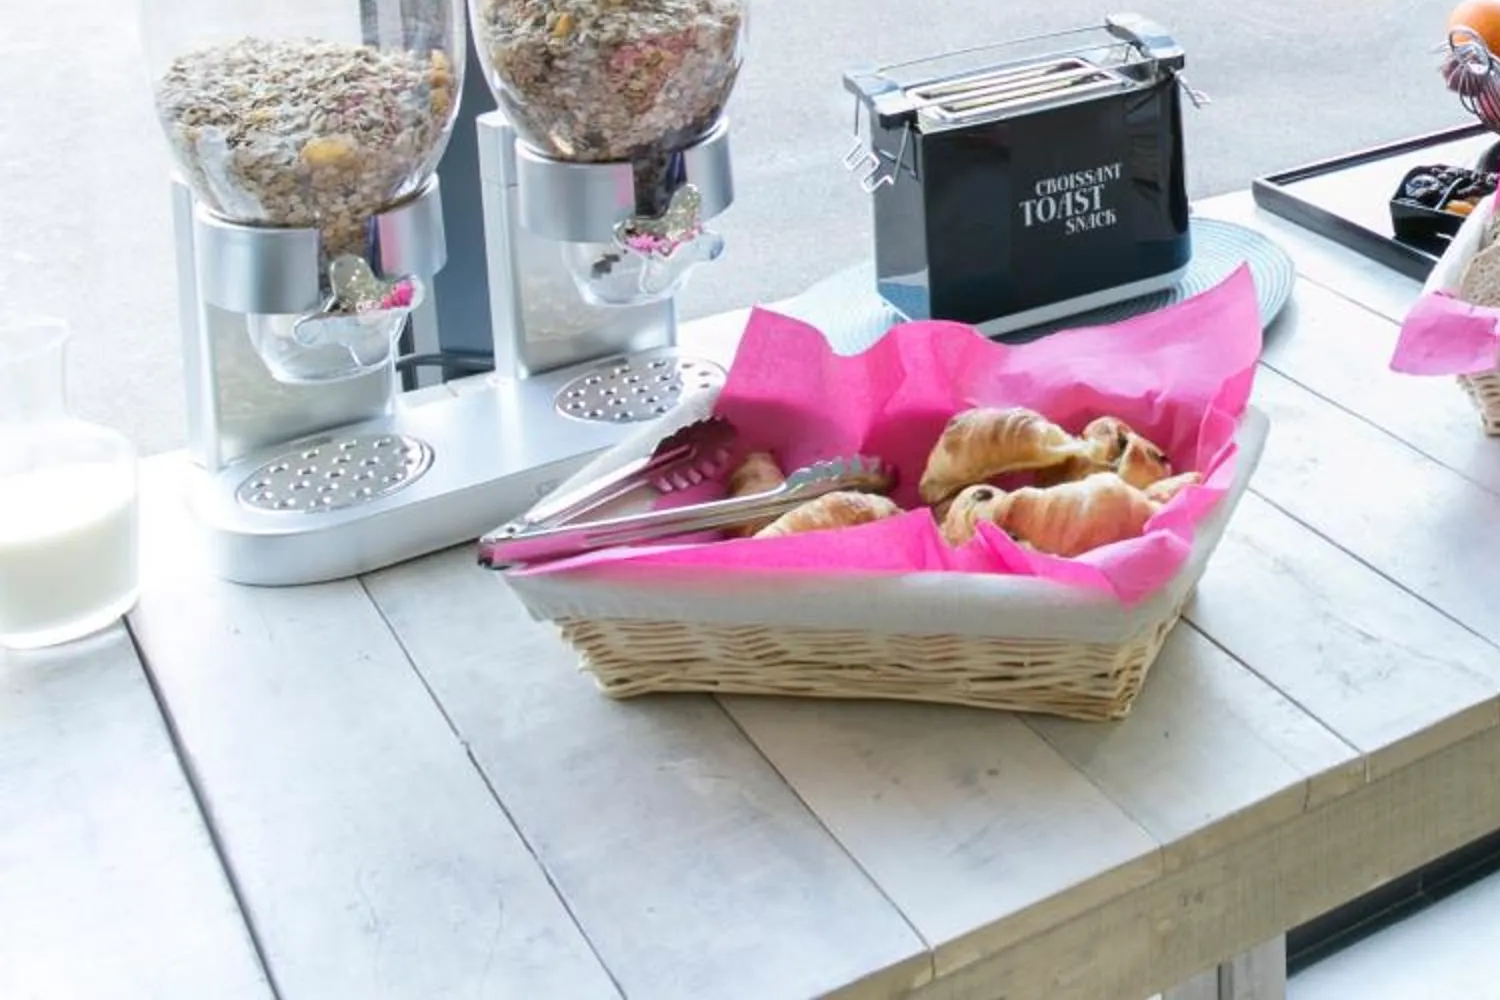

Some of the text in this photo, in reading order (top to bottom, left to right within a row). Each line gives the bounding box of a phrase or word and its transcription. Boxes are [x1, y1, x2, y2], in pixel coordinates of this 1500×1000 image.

[1035, 162, 1122, 197] CROISSANT
[1018, 184, 1105, 227] TOAST
[1065, 208, 1117, 236] SNACK
